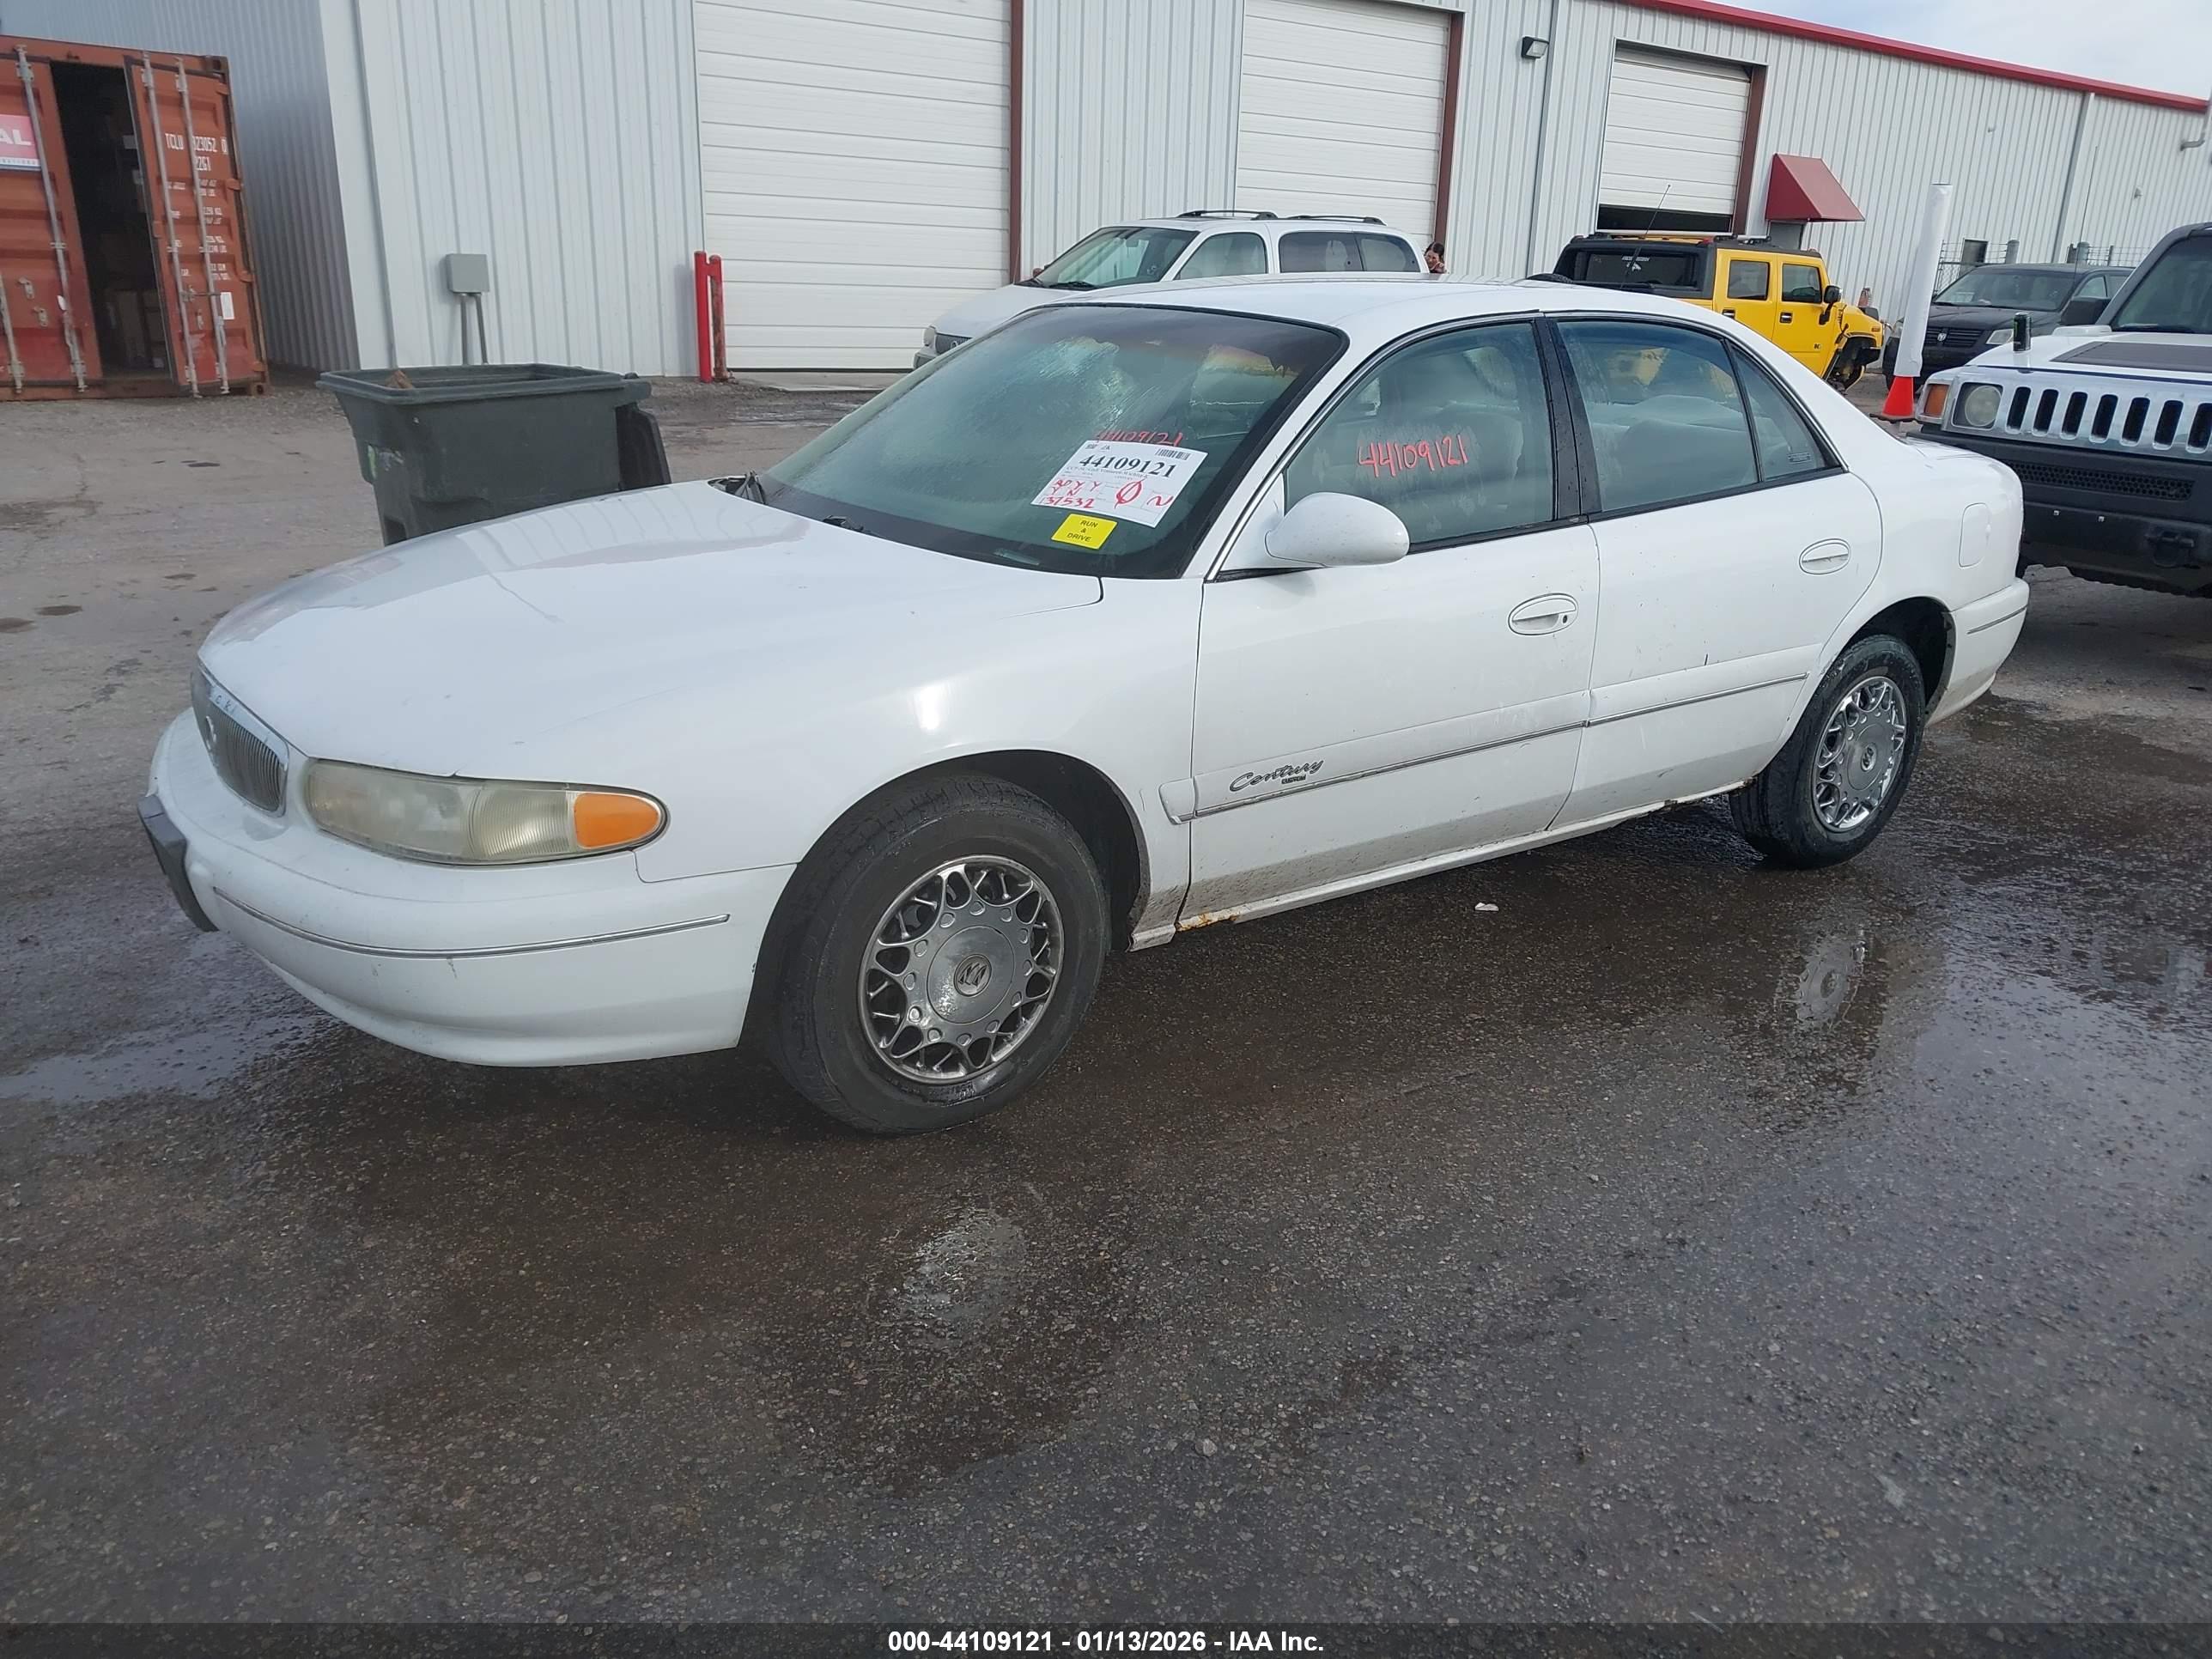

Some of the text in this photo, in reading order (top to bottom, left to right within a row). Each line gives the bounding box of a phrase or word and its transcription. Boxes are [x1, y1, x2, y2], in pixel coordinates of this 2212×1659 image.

[1079, 453, 1176, 478] 44109121
[1358, 434, 1468, 477] 44109121
[1079, 520, 1098, 529] RUN
[1066, 532, 1091, 543] DRIVE
[1229, 760, 1324, 792] Century
